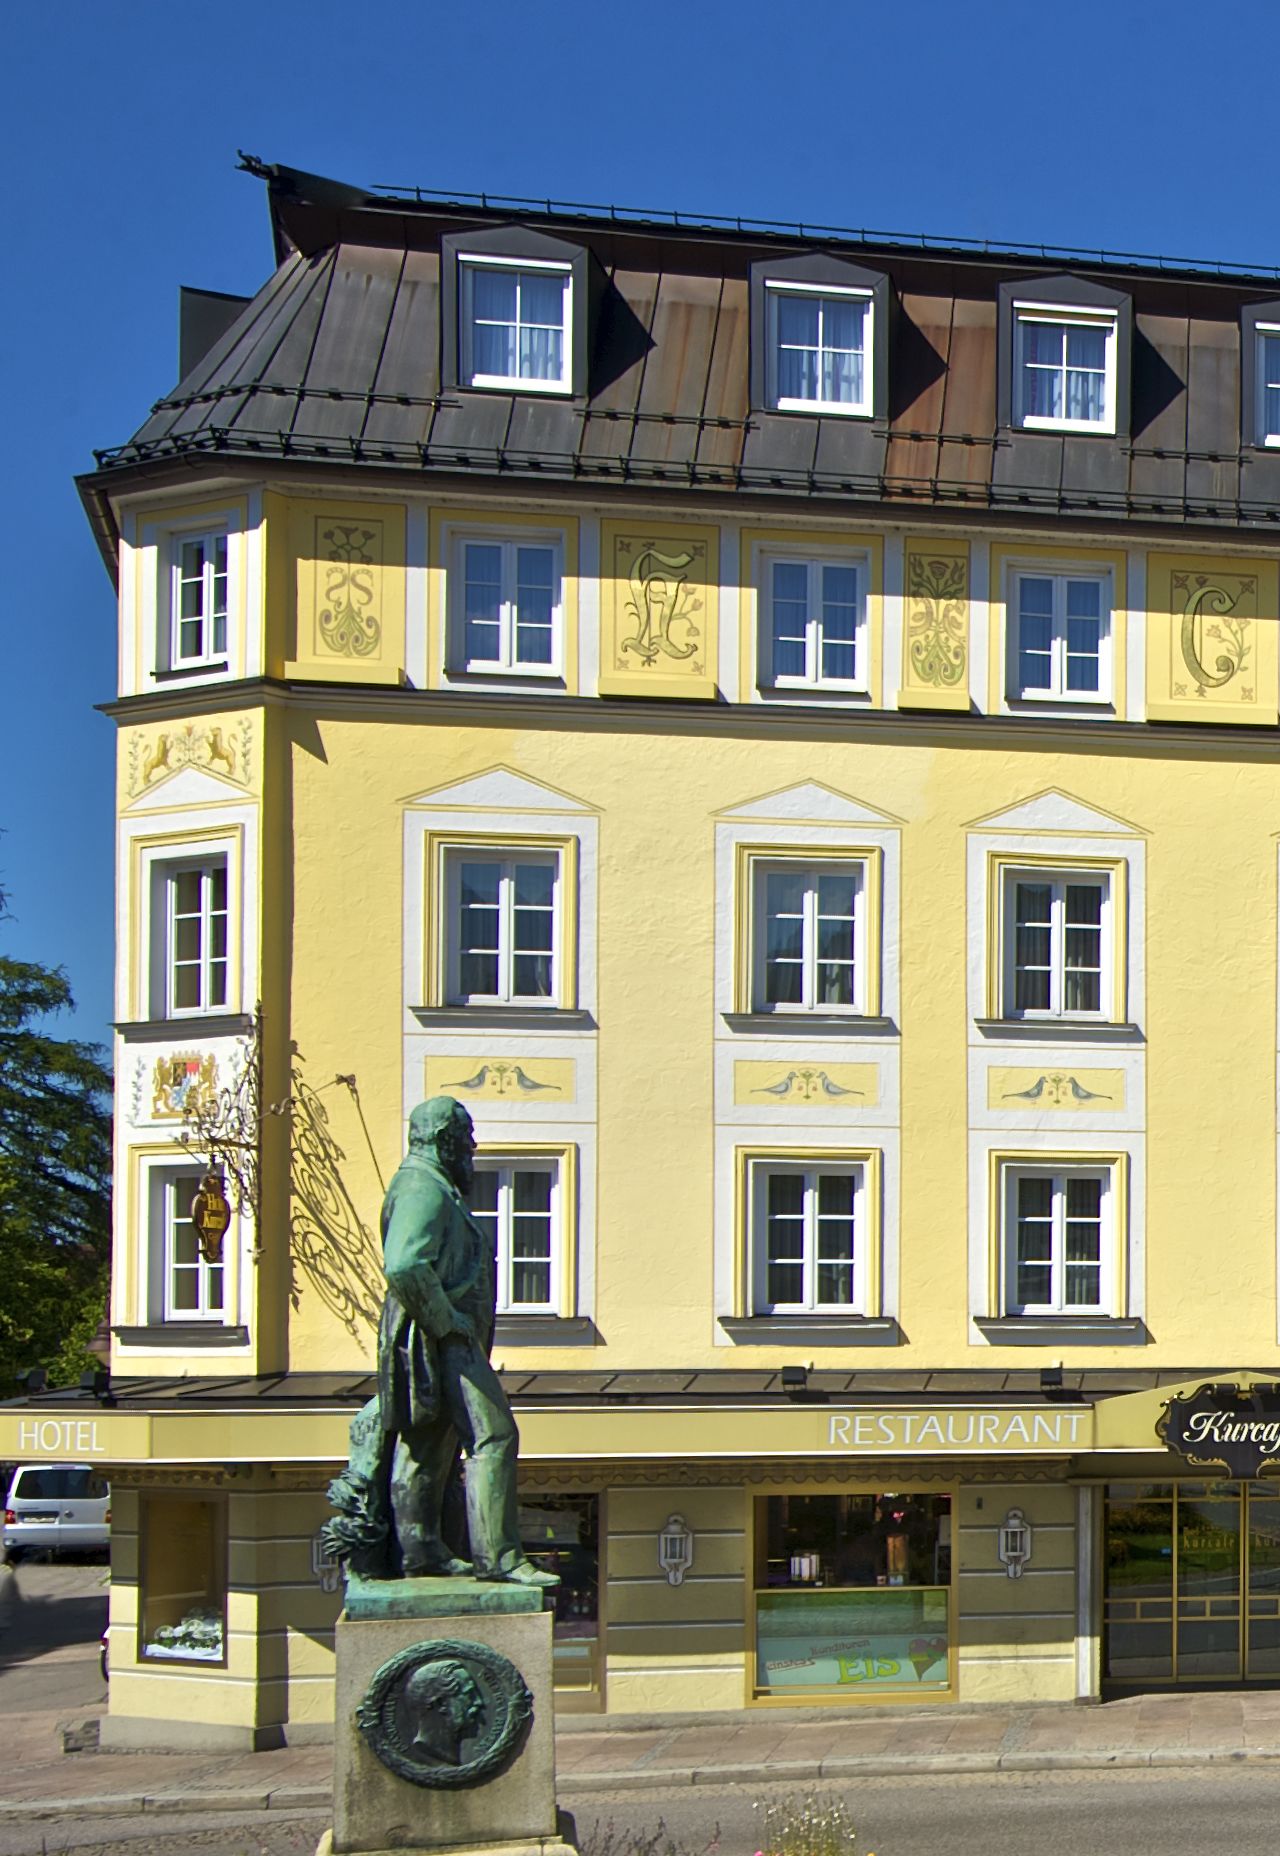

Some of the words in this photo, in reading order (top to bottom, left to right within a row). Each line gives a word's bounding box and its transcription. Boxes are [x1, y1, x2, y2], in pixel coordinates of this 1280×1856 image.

[20, 1420, 105, 1451] HOTEL
[829, 1414, 1085, 1444] RESTAURANT
[836, 1650, 900, 1685] Eis
